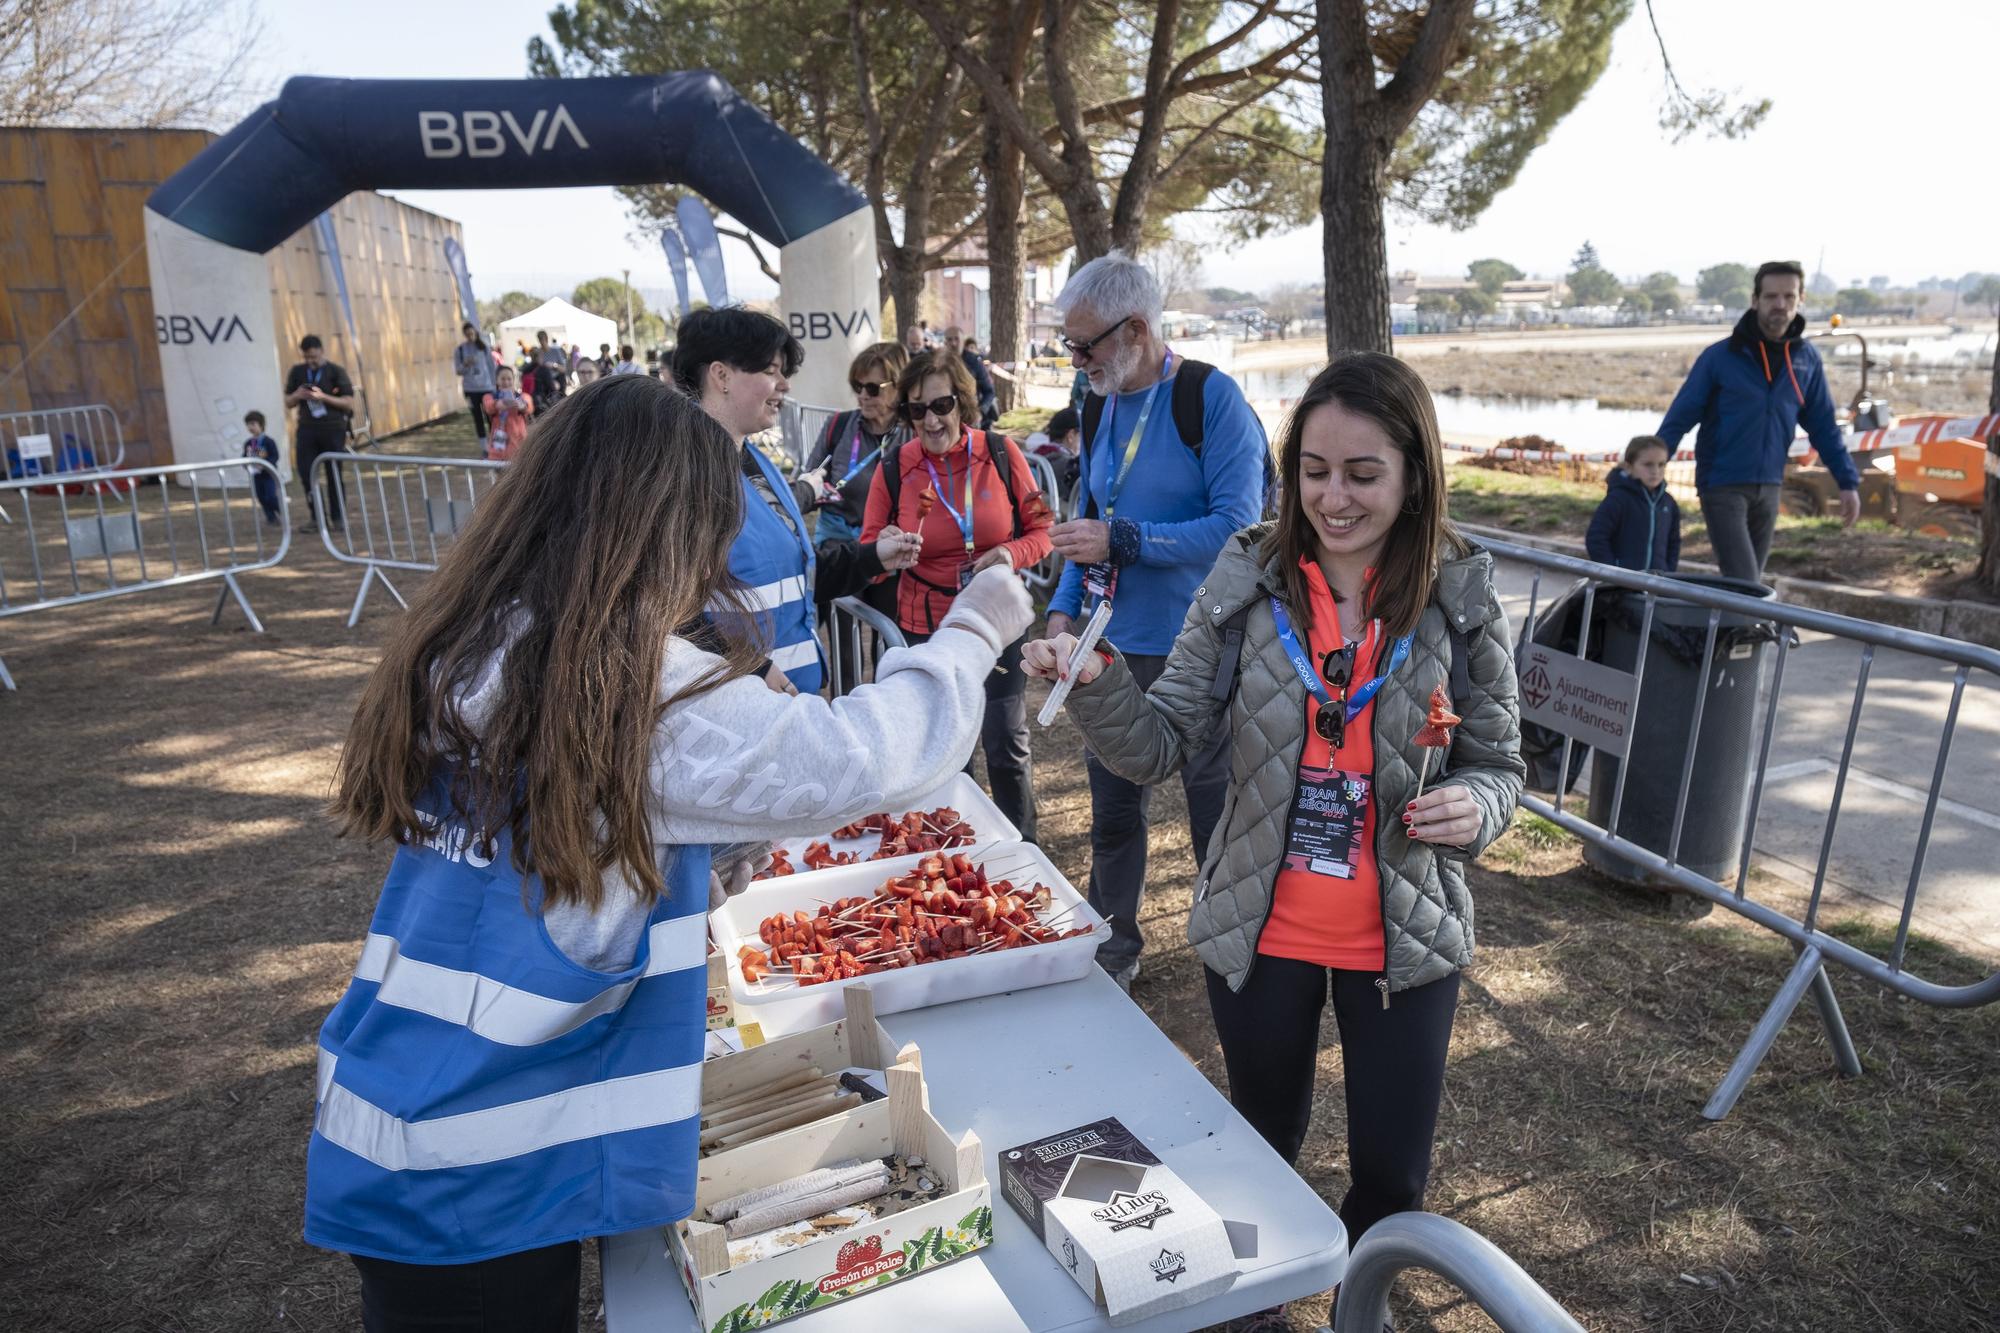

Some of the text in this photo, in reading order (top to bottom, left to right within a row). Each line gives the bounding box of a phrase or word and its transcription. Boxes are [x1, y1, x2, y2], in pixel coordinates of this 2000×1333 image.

[418, 102, 591, 159] BBVA
[156, 313, 253, 345] BBVA
[789, 307, 875, 340] BBVA
[1555, 676, 1629, 716] Ajuntament
[1553, 699, 1624, 737] de Manresa
[1301, 785, 1337, 801] TRAN
[1322, 811, 1343, 819] 2023
[822, 1255, 903, 1291] Fresón de Palos
